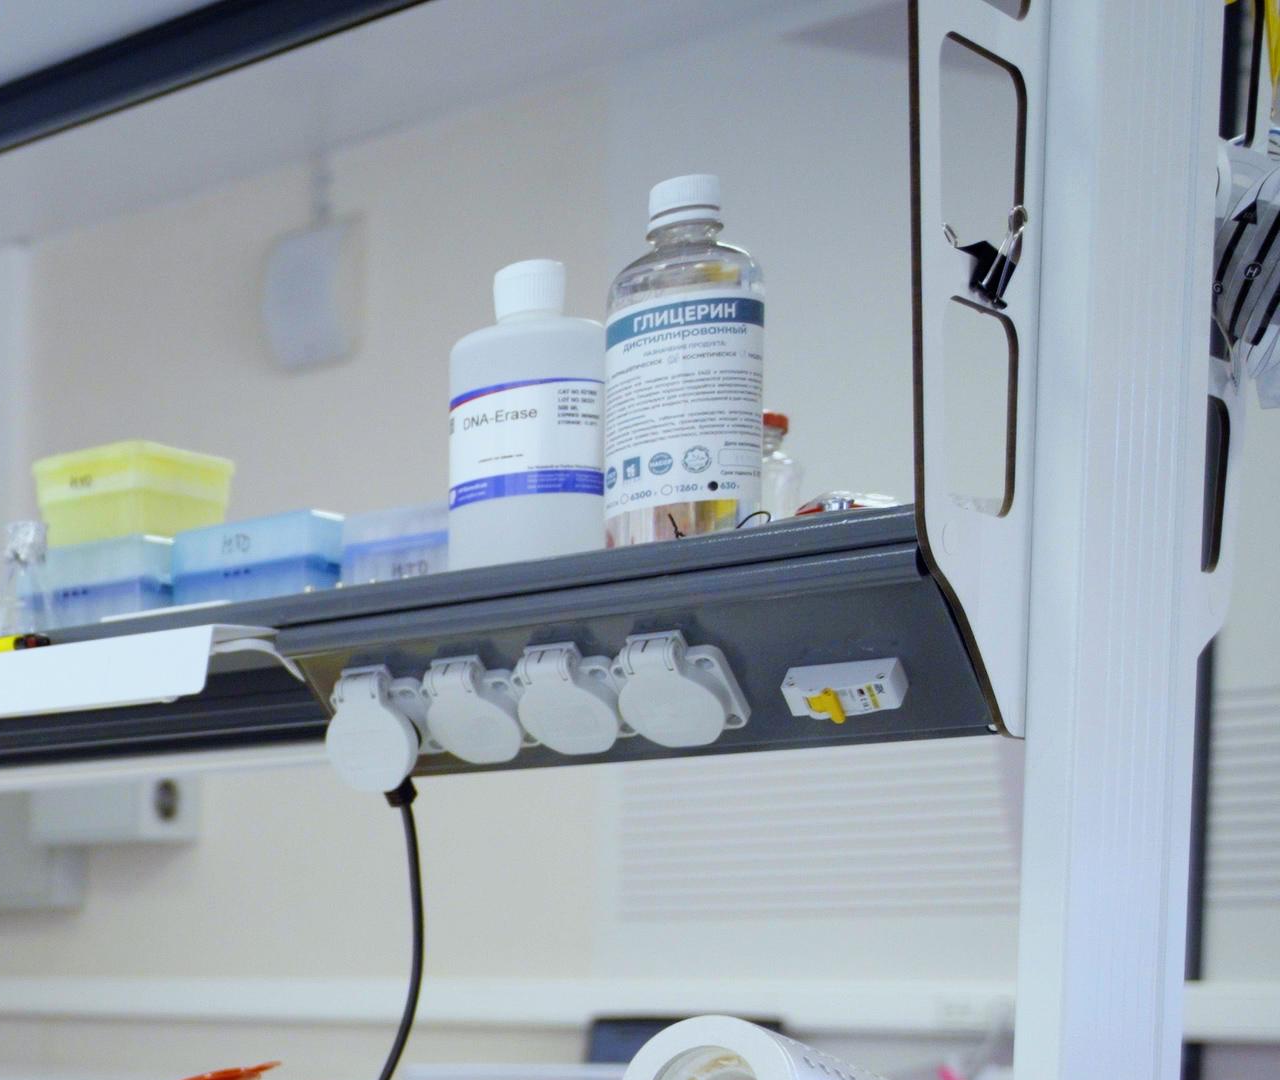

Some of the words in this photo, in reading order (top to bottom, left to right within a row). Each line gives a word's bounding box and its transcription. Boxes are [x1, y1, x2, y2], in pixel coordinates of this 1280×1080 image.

[632, 302, 737, 333] ГЛИЦЕРИН
[623, 325, 748, 353] дистиллированный
[463, 408, 538, 431] DNA-Erase
[630, 490, 652, 501] 6300
[675, 484, 698, 492] 1260
[720, 480, 736, 490] 630
